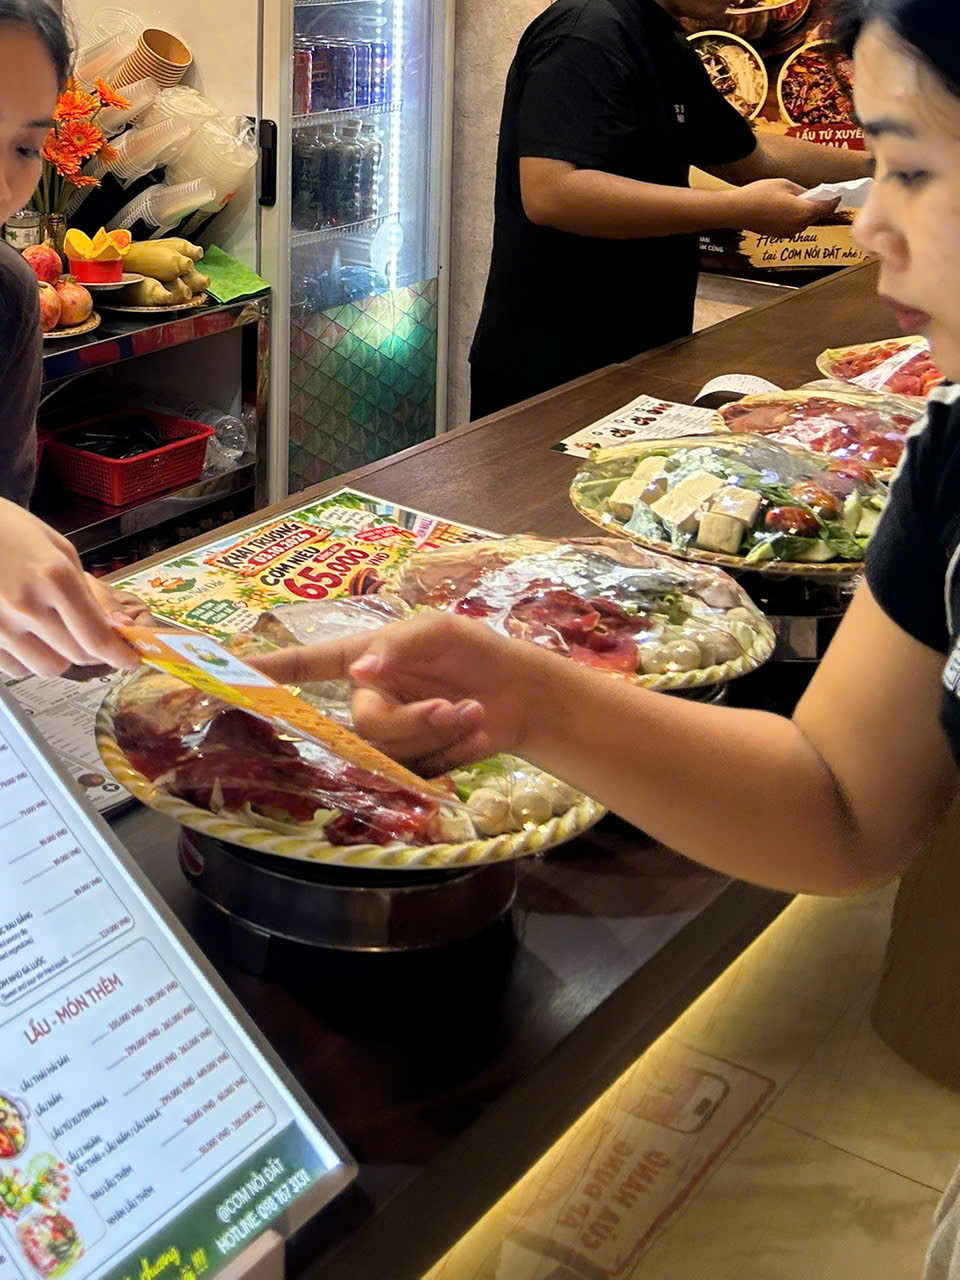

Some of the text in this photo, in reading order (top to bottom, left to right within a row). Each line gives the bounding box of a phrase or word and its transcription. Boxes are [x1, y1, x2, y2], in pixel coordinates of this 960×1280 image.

[763, 249, 778, 263] tại
[780, 247, 802, 260] CƠM
[823, 245, 841, 260] ĐẤT
[216, 521, 302, 569] KHAI TRƯƠNG
[260, 546, 321, 587] CƠM NIÊU
[283, 548, 371, 600] 65.000
[56, 994, 90, 1026] MÓN
[84, 973, 123, 1008] THÊM
[214, 1209, 263, 1255] HOTLINE:
[257, 1194, 279, 1220] 098
[275, 1182, 293, 1206] 167
